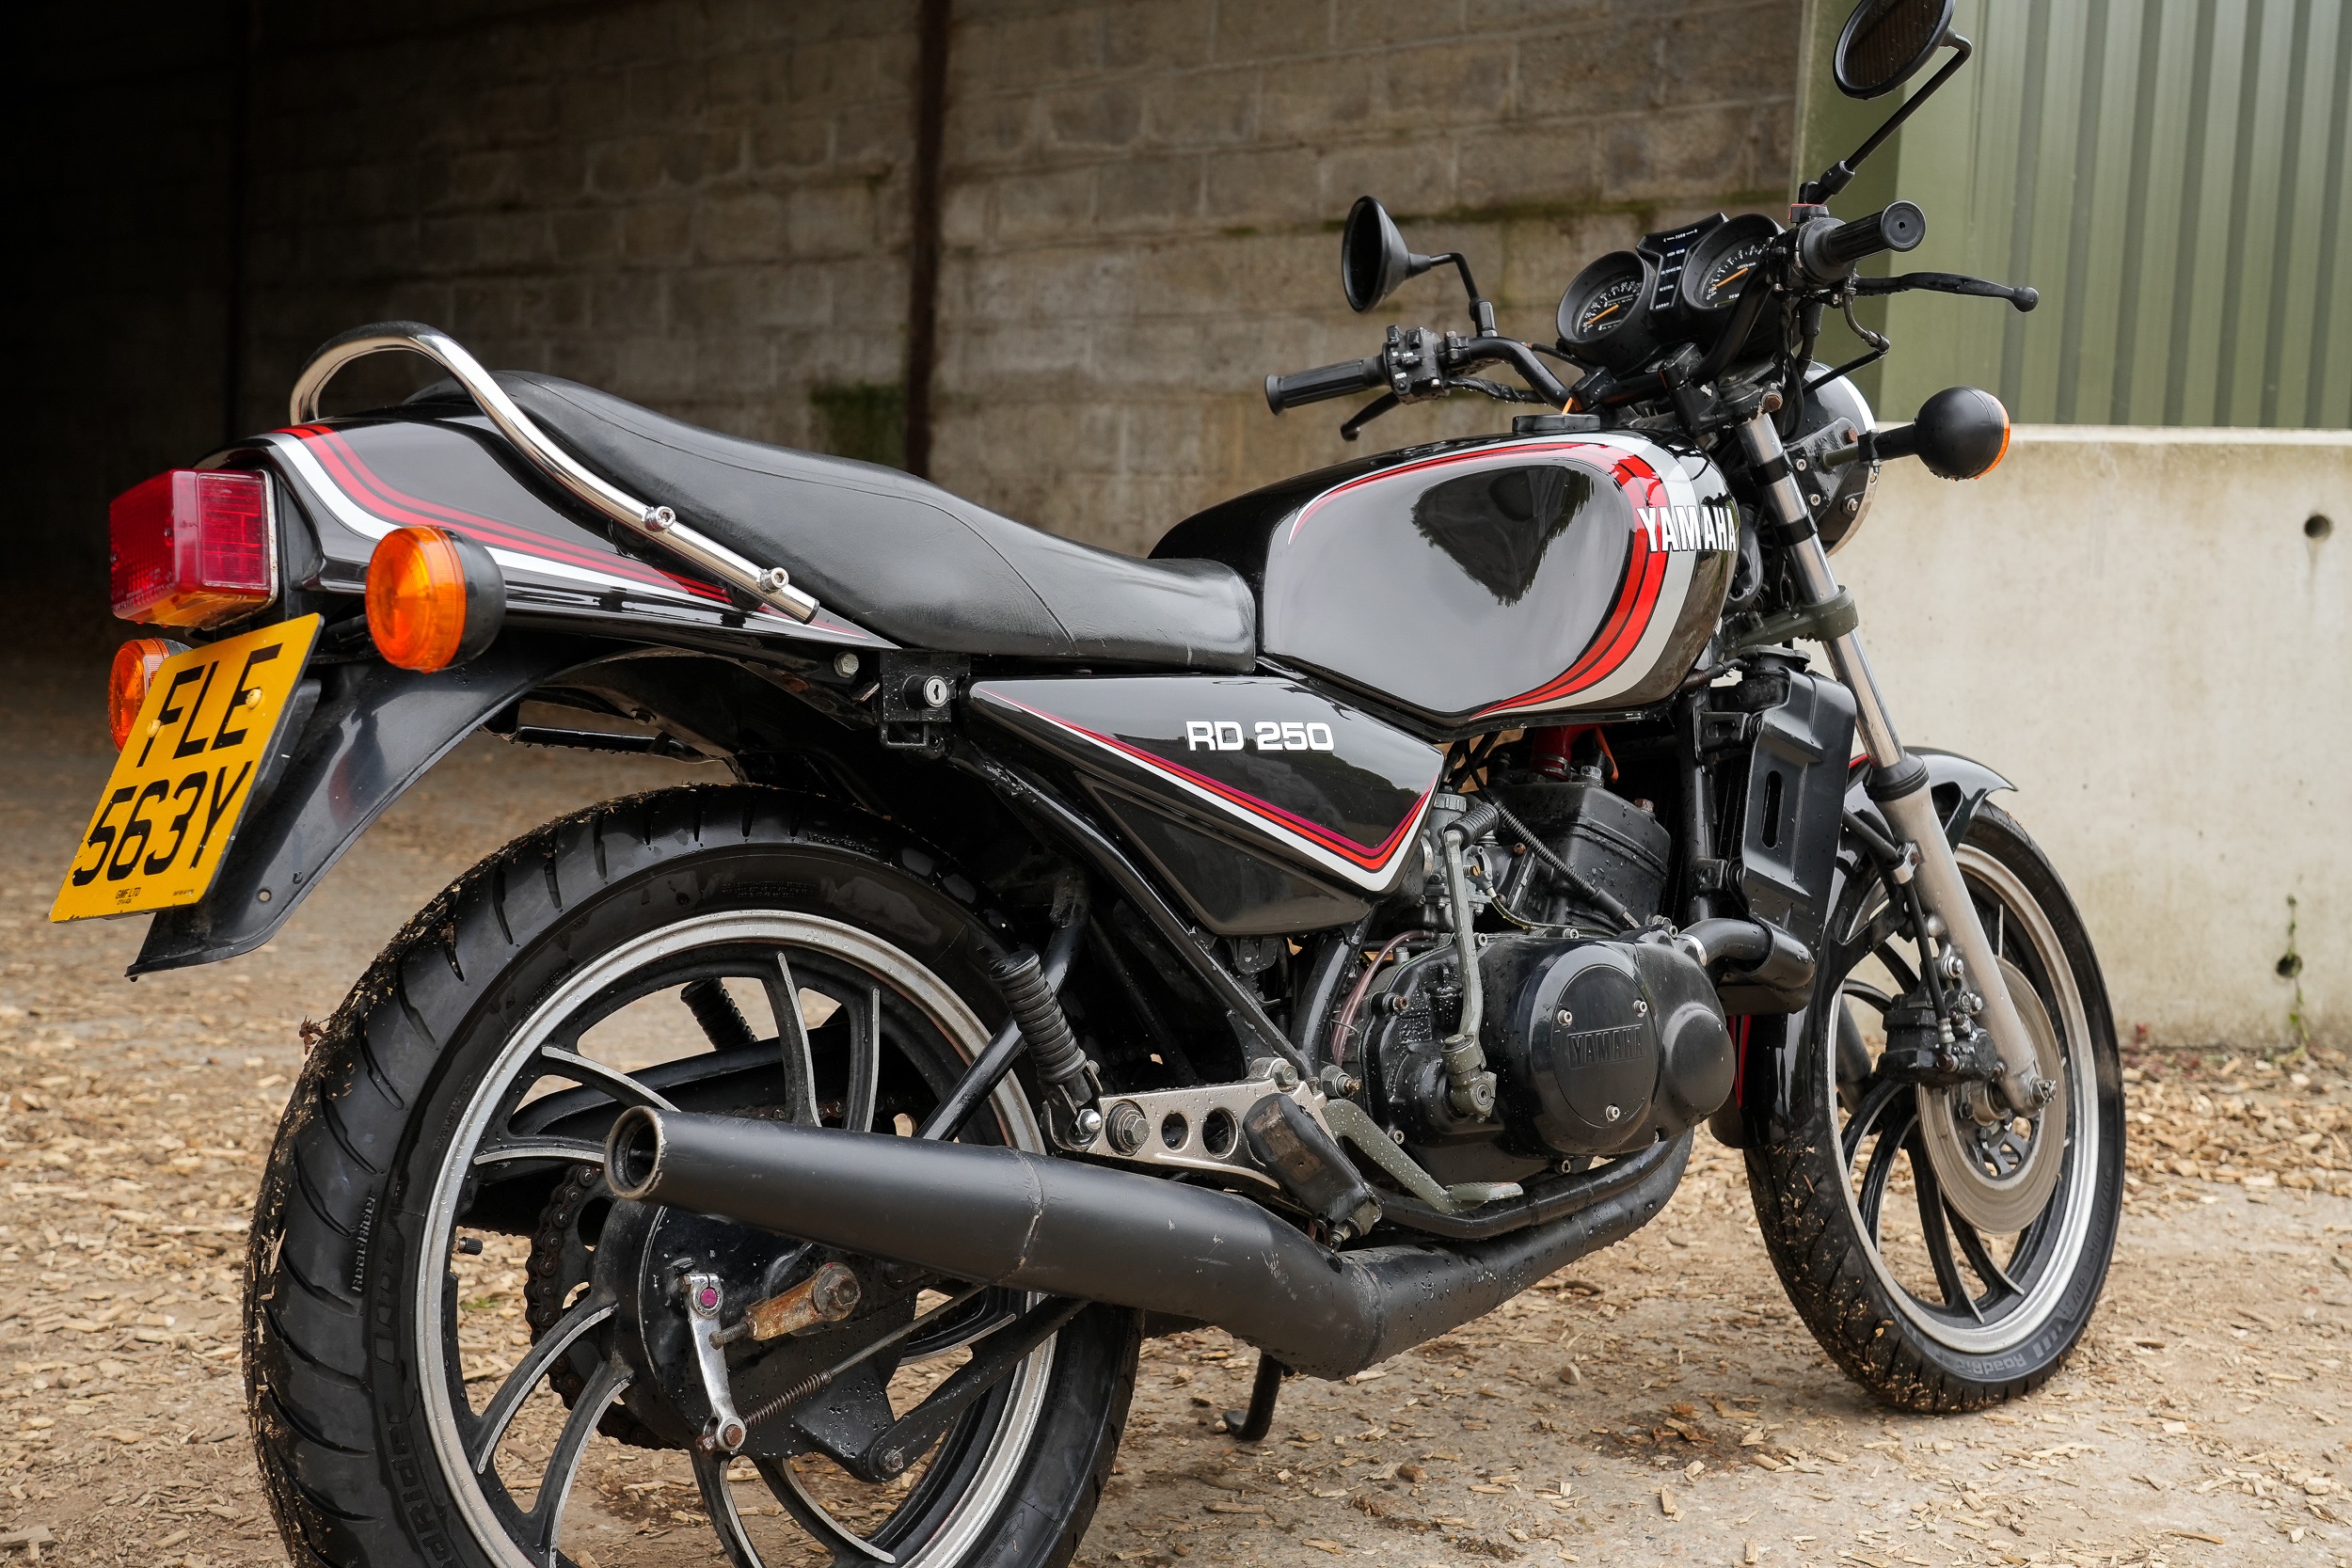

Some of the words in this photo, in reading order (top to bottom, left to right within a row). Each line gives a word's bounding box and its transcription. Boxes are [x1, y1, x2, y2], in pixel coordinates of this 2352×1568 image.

[1635, 505, 1737, 553] YAMAHA
[135, 641, 284, 768] FLE
[1185, 721, 1245, 752] RD
[1254, 721, 1335, 752] 250
[72, 759, 254, 887] 563Y
[1570, 1026, 1643, 1069] YAMAHA
